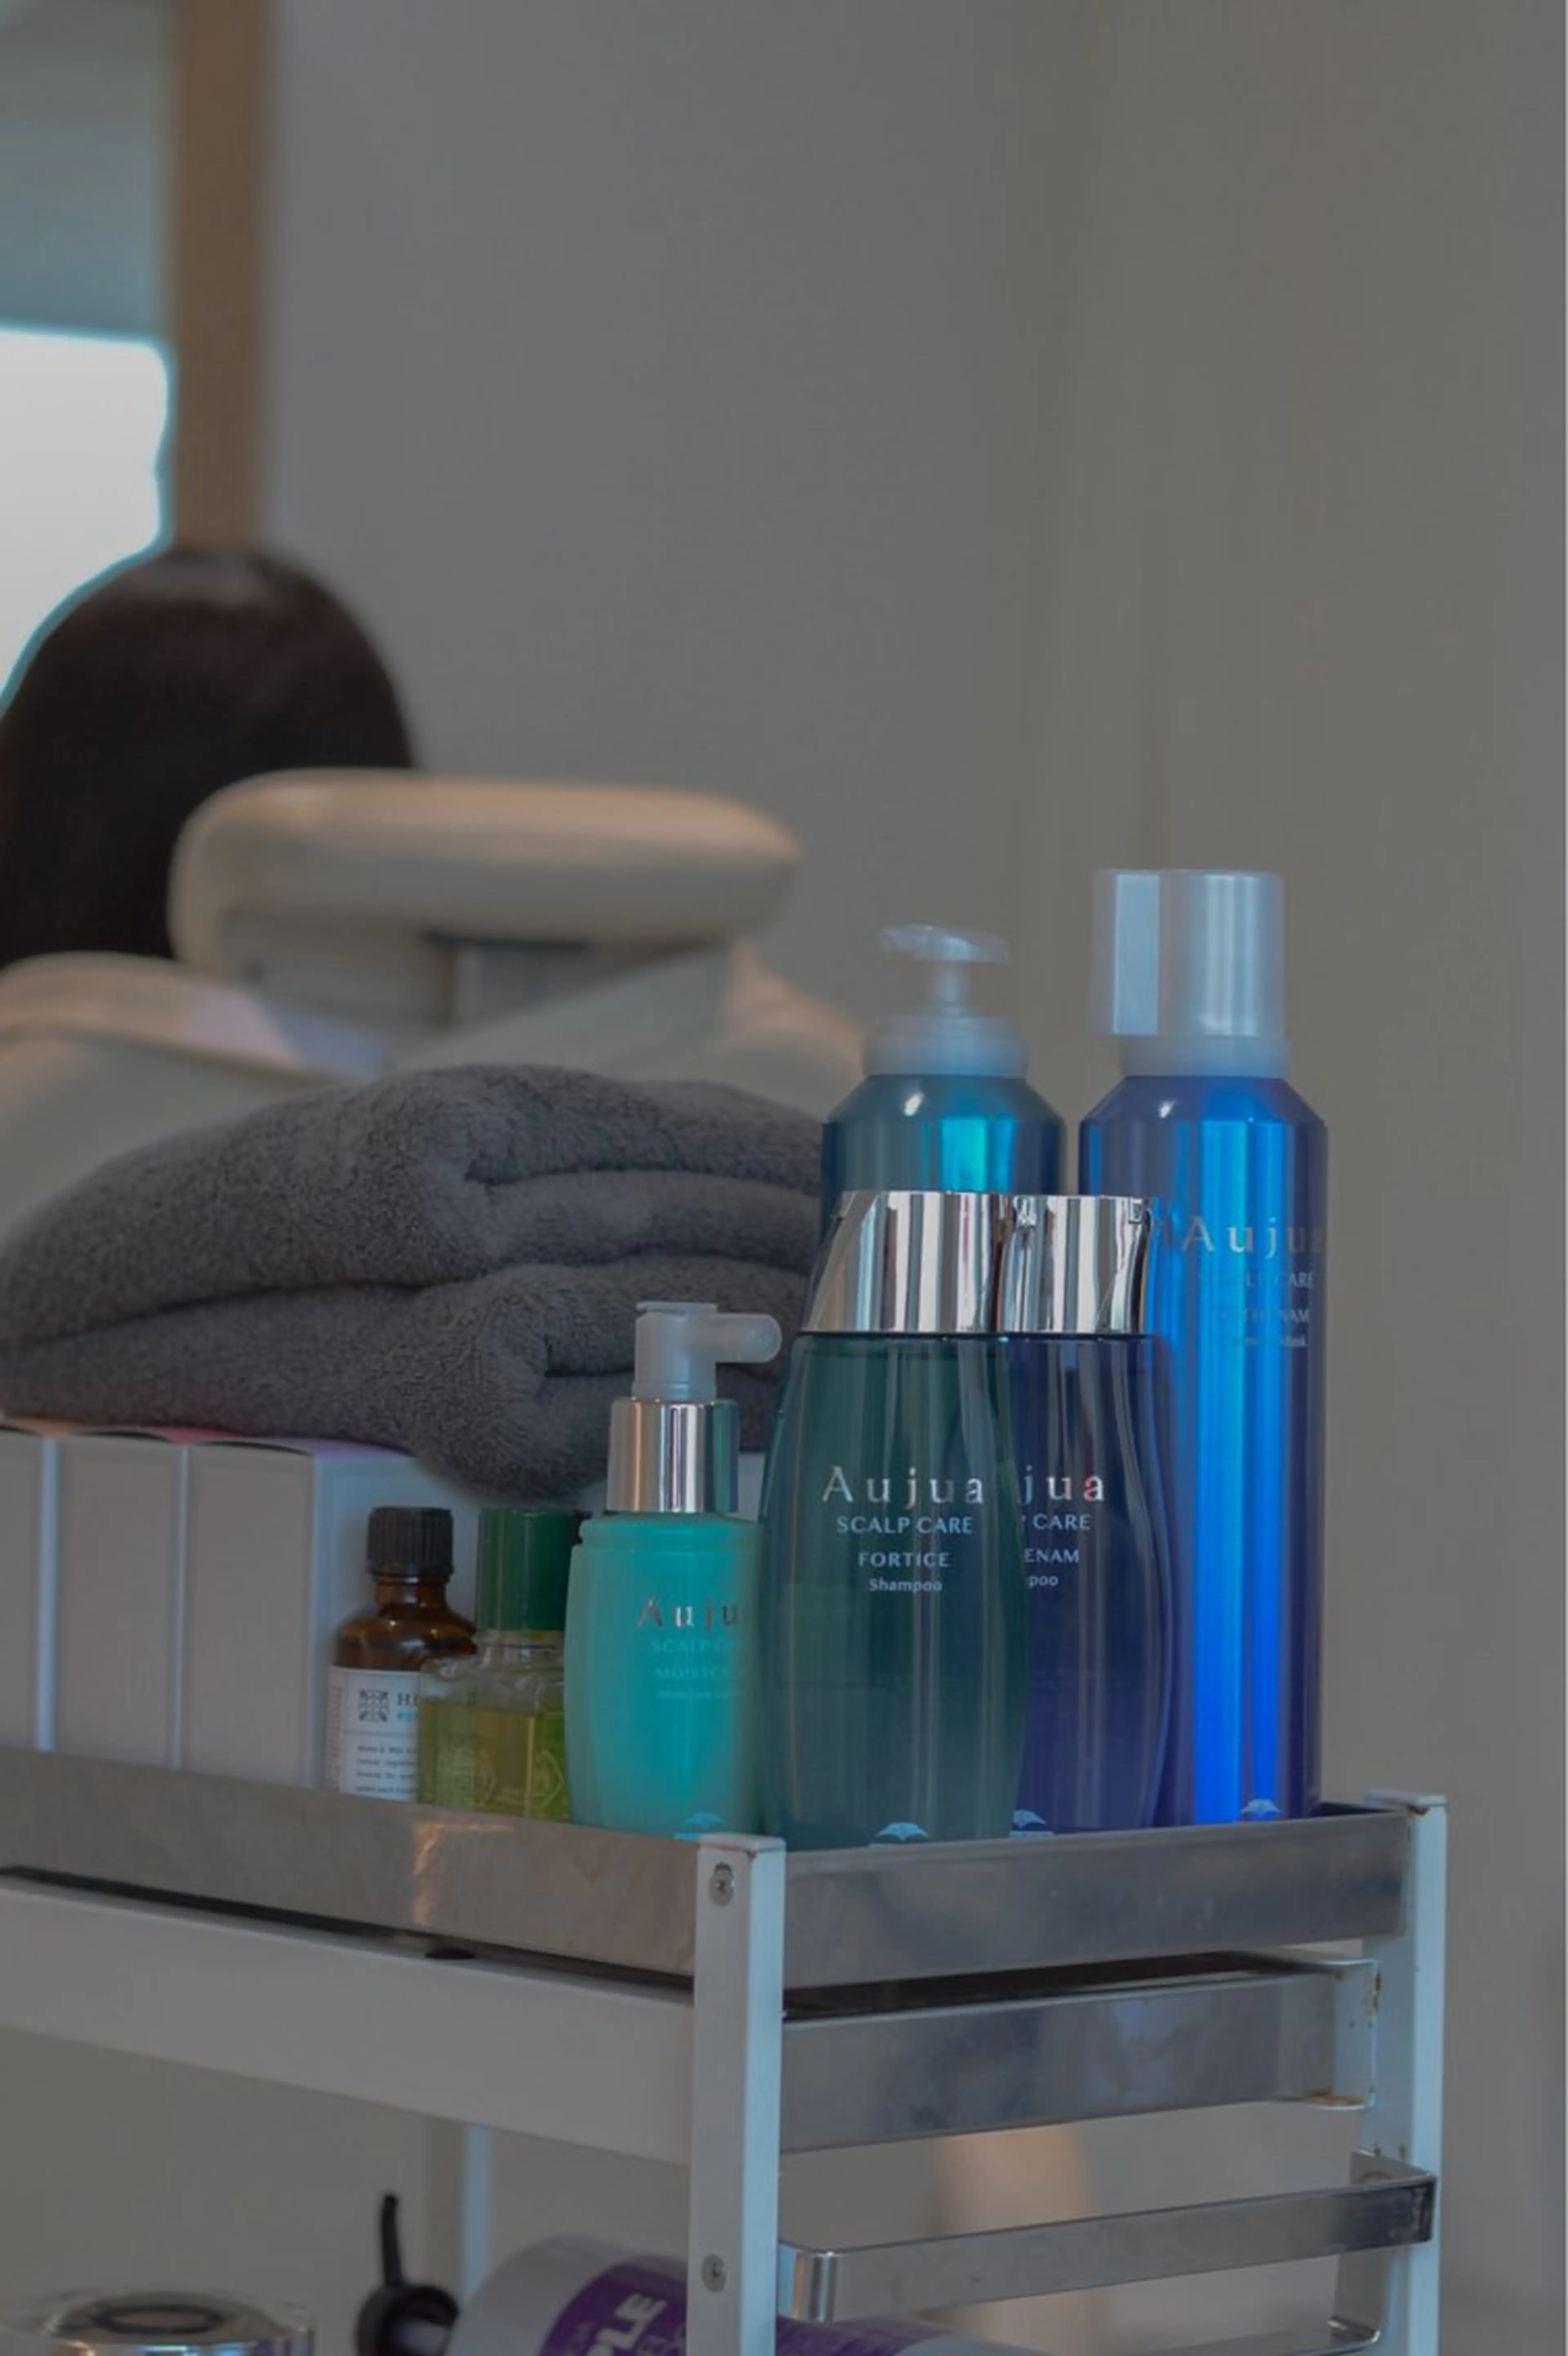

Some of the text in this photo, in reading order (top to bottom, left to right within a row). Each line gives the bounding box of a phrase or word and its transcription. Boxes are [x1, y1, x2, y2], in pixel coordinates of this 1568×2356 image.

[822, 1465, 984, 1510] Aujua
[836, 1515, 973, 1534] SCALP CARE
[1032, 1512, 1093, 1530] CARE
[858, 1552, 952, 1568] FORTICE
[868, 1576, 943, 1593] Shampoo
